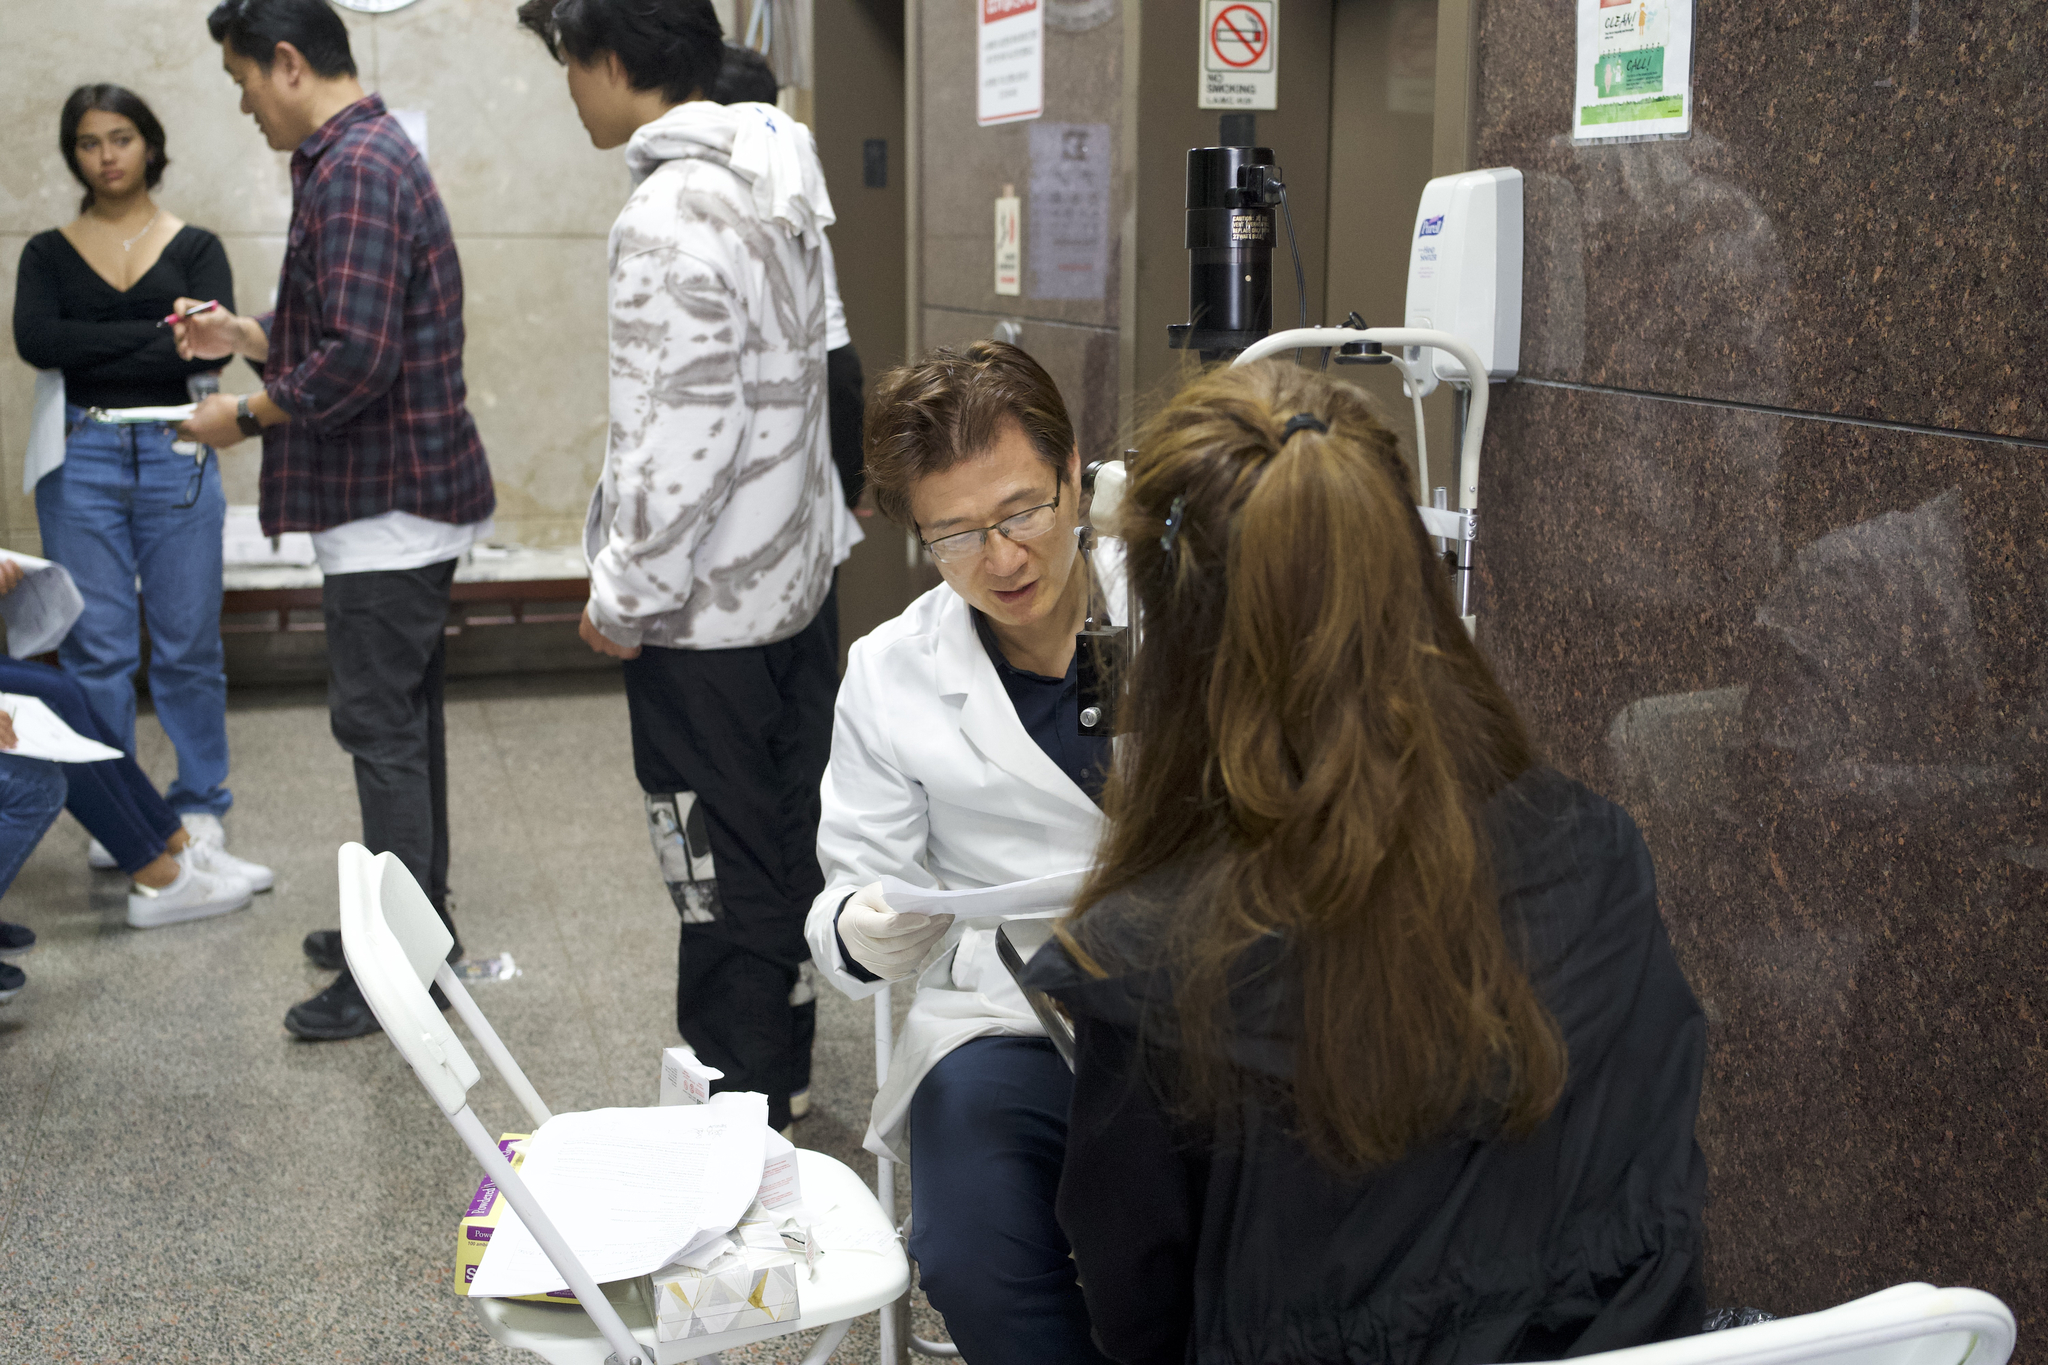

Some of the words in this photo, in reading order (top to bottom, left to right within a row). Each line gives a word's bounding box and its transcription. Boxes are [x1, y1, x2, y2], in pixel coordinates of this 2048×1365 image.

[1604, 11, 1637, 29] CLEAN!
[1626, 55, 1652, 72] CALL!
[1206, 74, 1224, 83] NO
[1206, 84, 1257, 95] SMOKING
